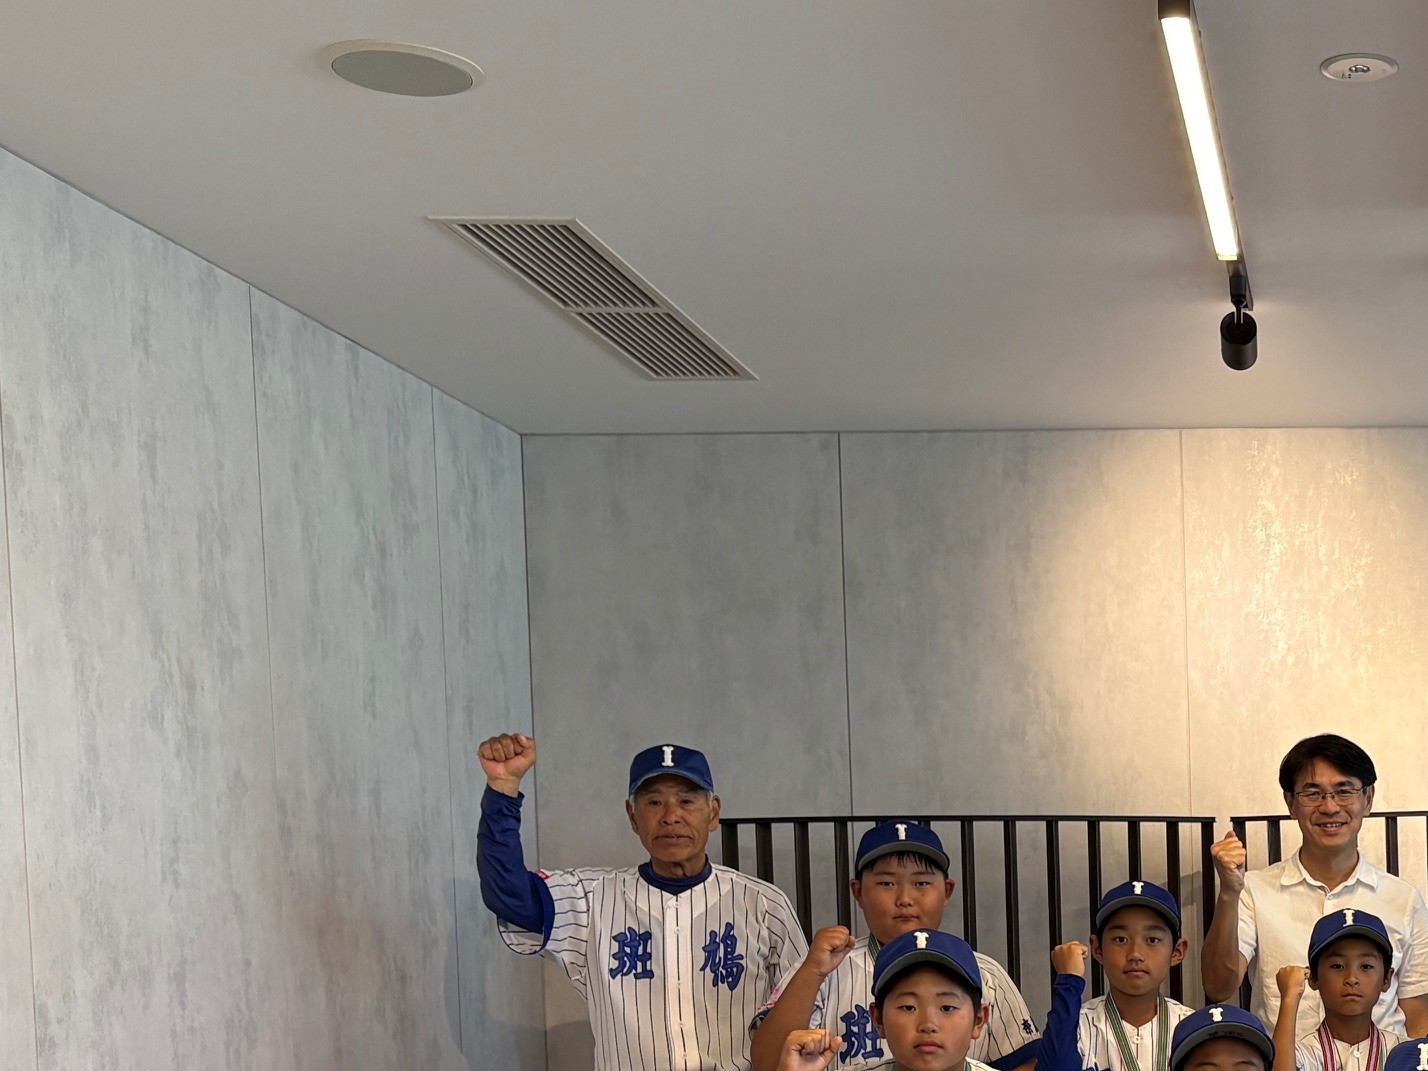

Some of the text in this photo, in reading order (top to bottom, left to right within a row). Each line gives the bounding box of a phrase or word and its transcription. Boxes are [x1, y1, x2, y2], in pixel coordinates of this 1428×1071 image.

[662, 744, 674, 766] I
[1342, 908, 1355, 926] I
[914, 931, 929, 949] I
[608, 922, 745, 990] 斑鳩
